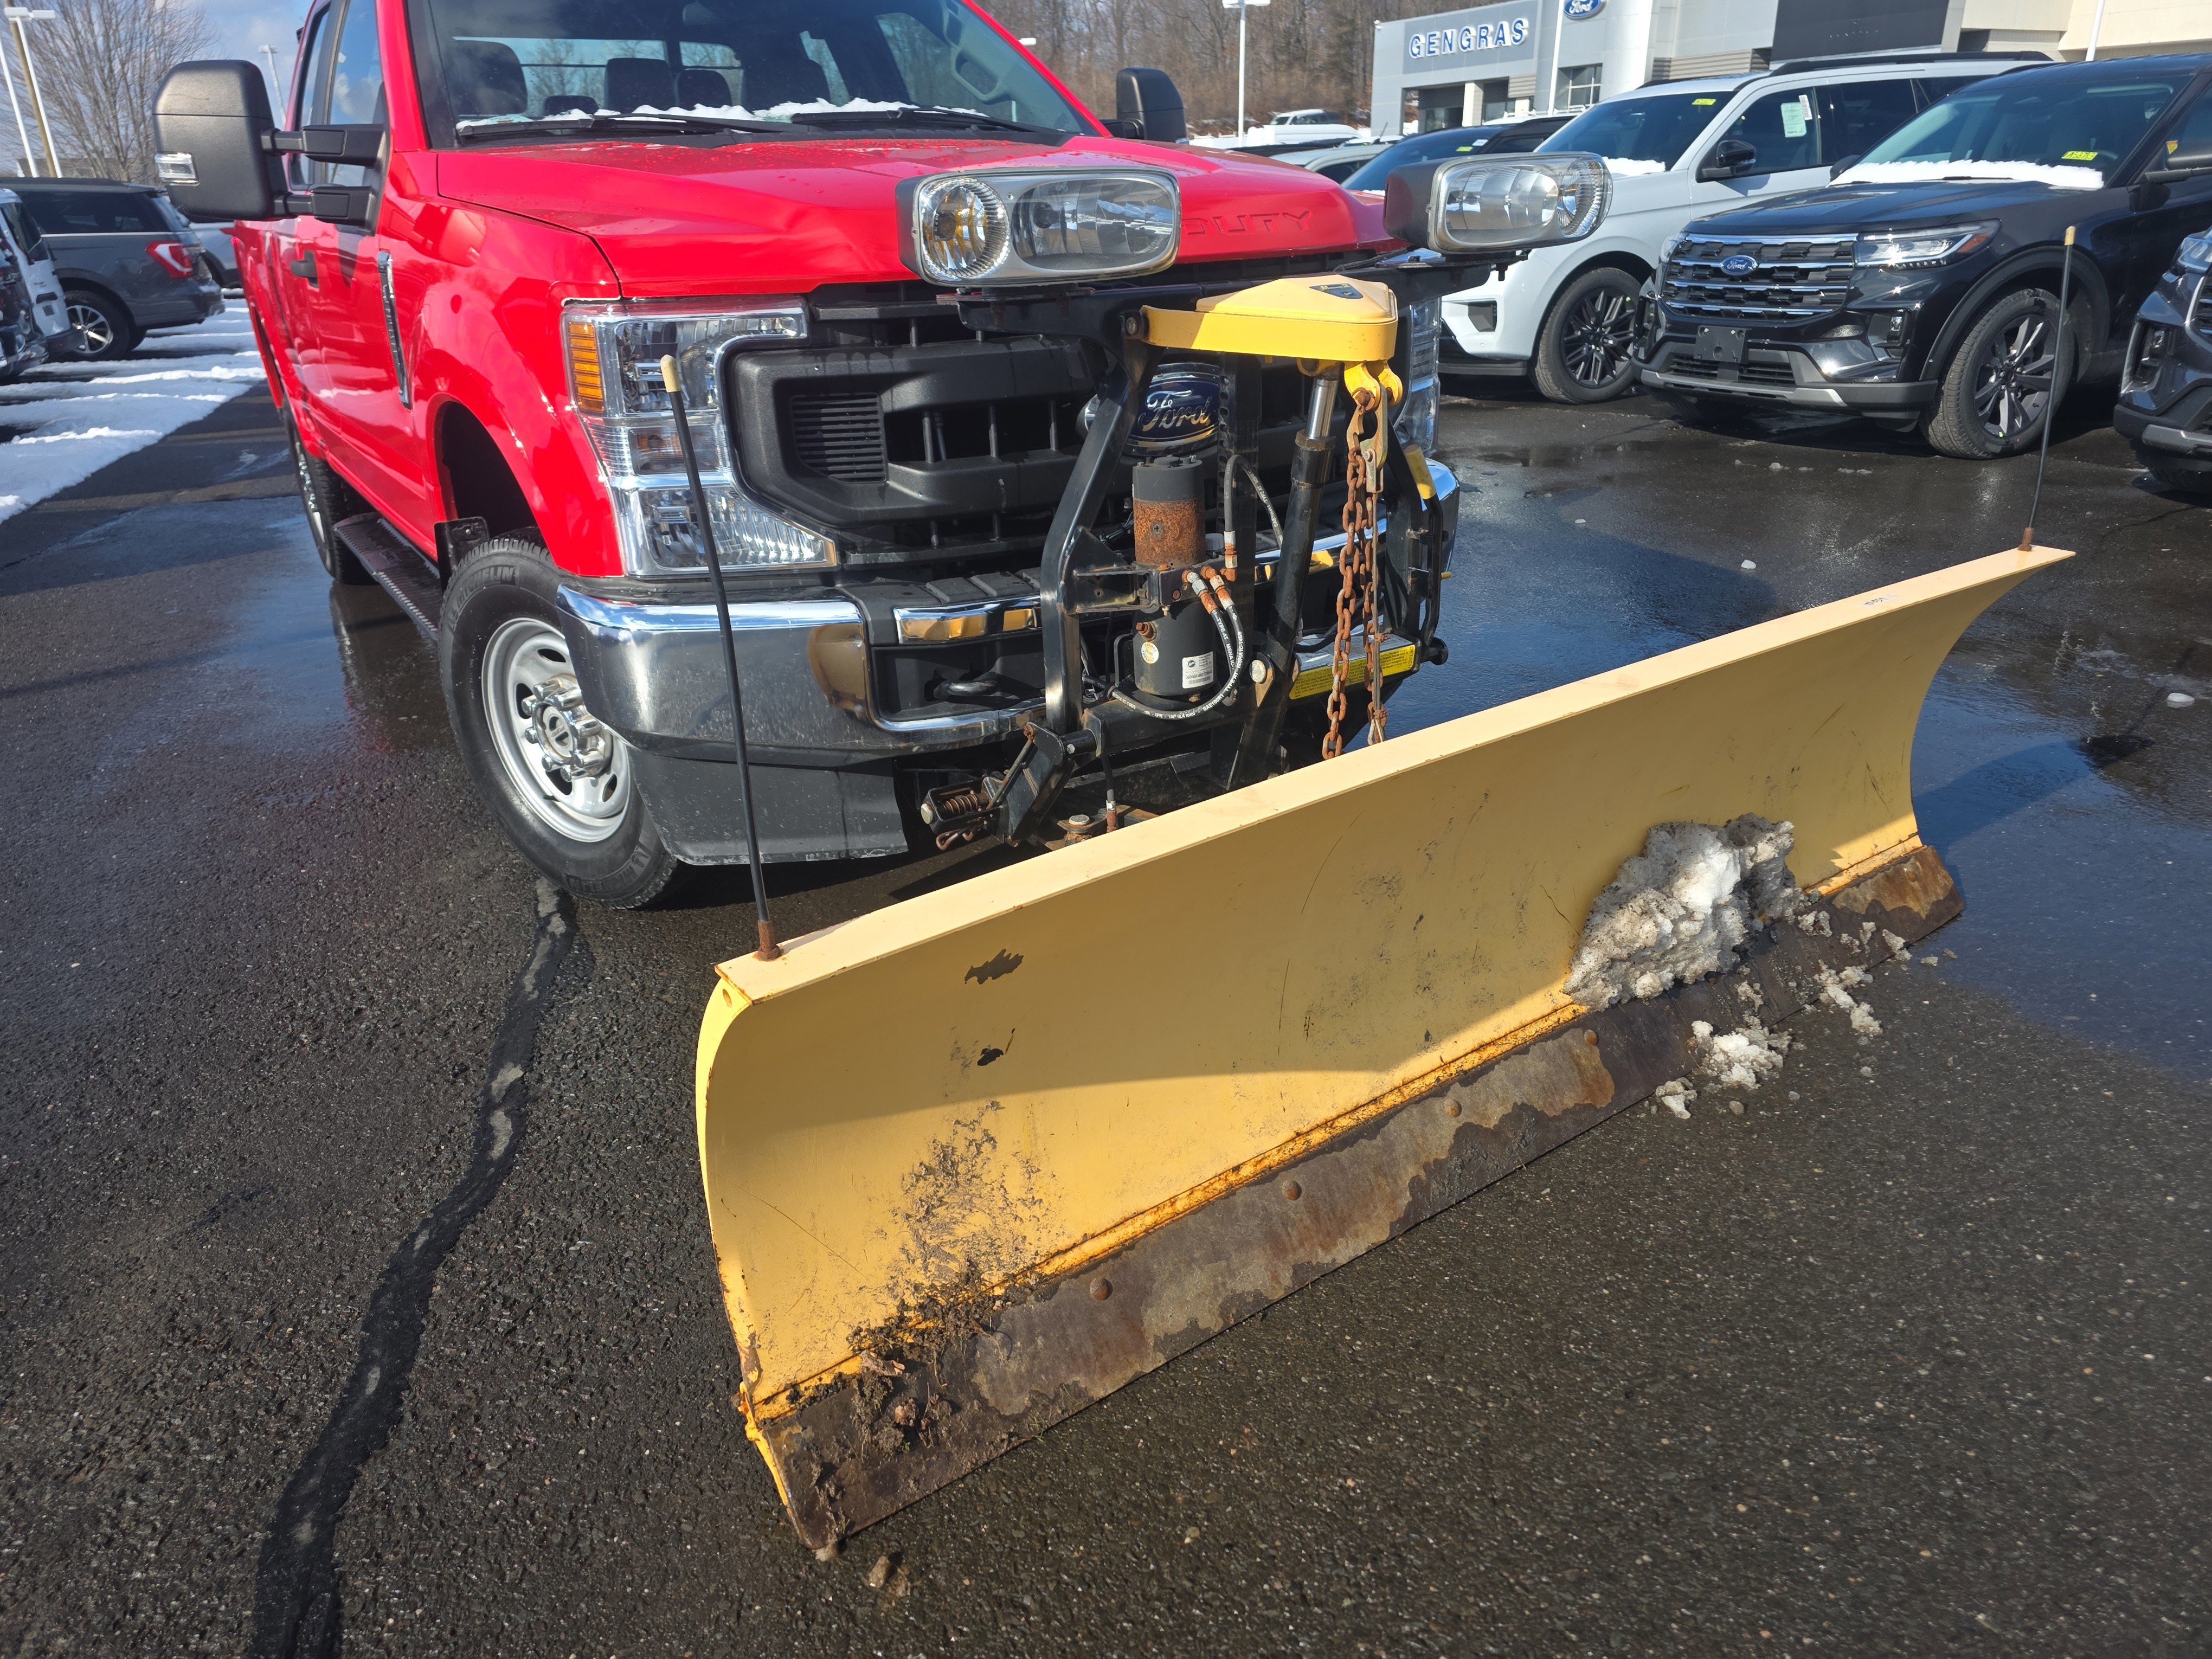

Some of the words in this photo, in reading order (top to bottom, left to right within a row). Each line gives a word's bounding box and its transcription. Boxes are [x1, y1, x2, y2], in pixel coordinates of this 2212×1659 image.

[1569, 0, 1593, 14] Ford
[1410, 18, 1528, 59] GENGRAS
[1181, 211, 1312, 235] DUTY
[1727, 259, 1747, 270] Ford
[1138, 390, 1213, 432] Ford
[1217, 617, 1226, 633] TYPE
[1222, 632, 1229, 640] AT
[1225, 643, 1233, 661] MSHA
[1203, 693, 1225, 711] SAE100R1
[1225, 679, 1236, 692] TYPE
[1232, 671, 1239, 679] AT
